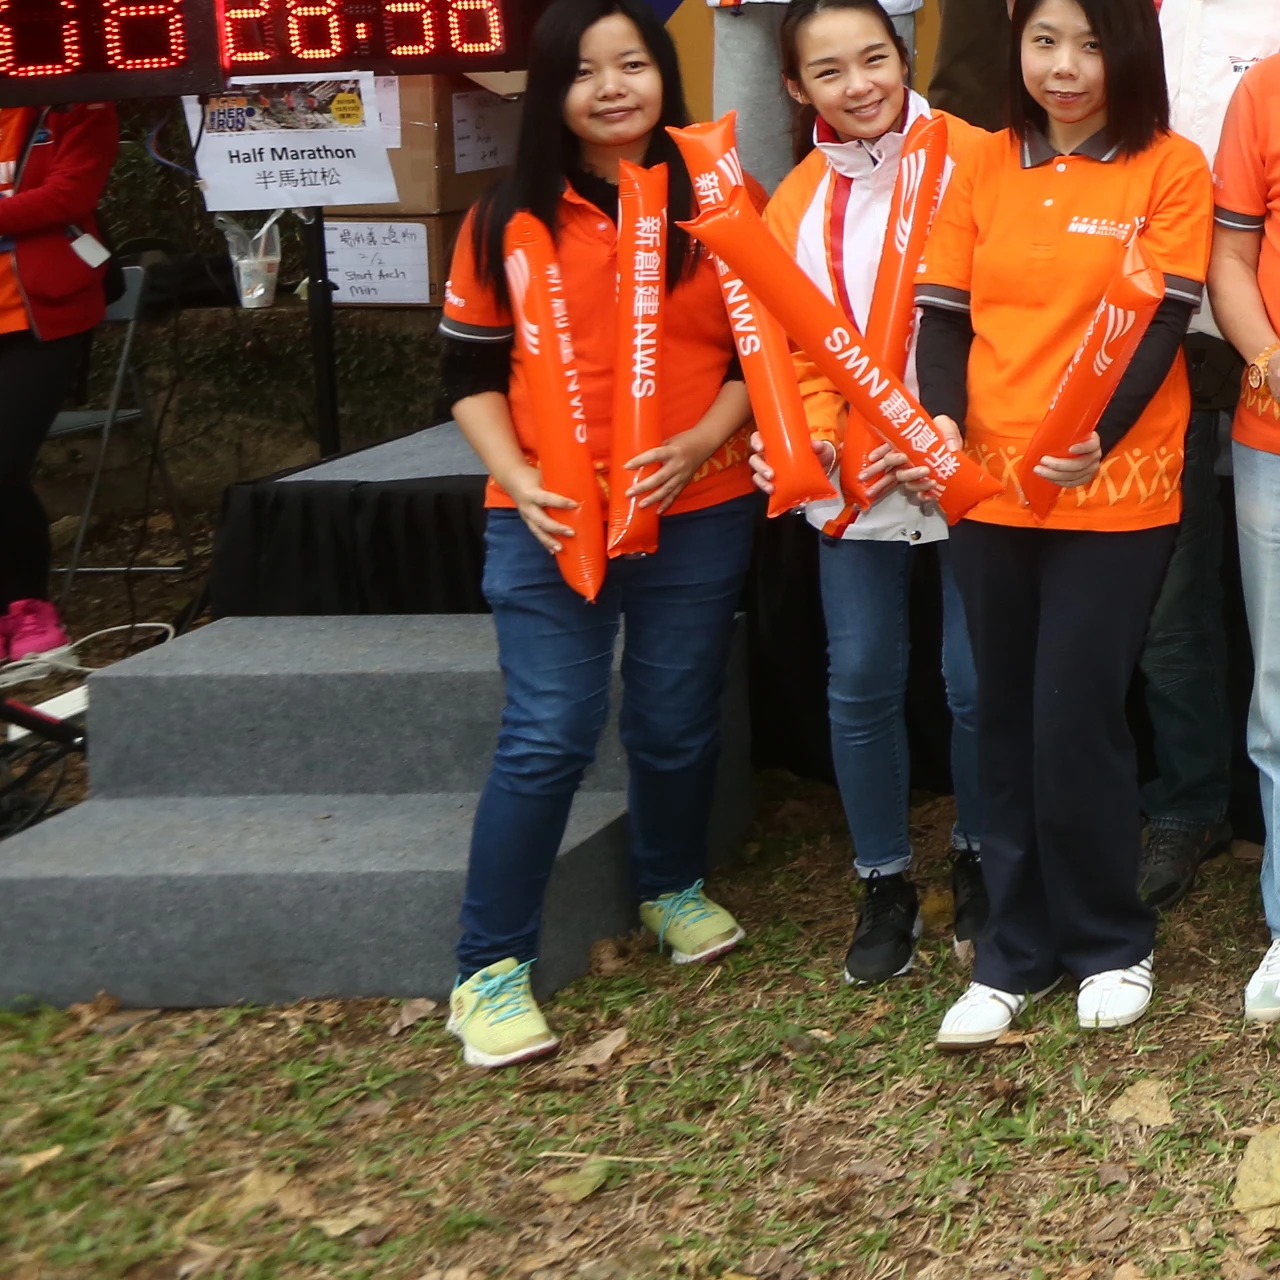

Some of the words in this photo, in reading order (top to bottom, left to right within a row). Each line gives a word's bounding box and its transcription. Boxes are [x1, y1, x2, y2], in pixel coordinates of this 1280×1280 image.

[216, 118, 247, 130] RUN
[217, 106, 256, 119] HERO
[228, 148, 264, 165] Half
[271, 145, 356, 163] Marathon
[255, 167, 341, 190] 半馬拉松
[1067, 221, 1097, 235] NWS
[632, 215, 665, 317] 新創建
[722, 277, 762, 358] NWS
[630, 323, 658, 399] NWS
[823, 325, 891, 398] NWS
[878, 386, 962, 484] 新創建
